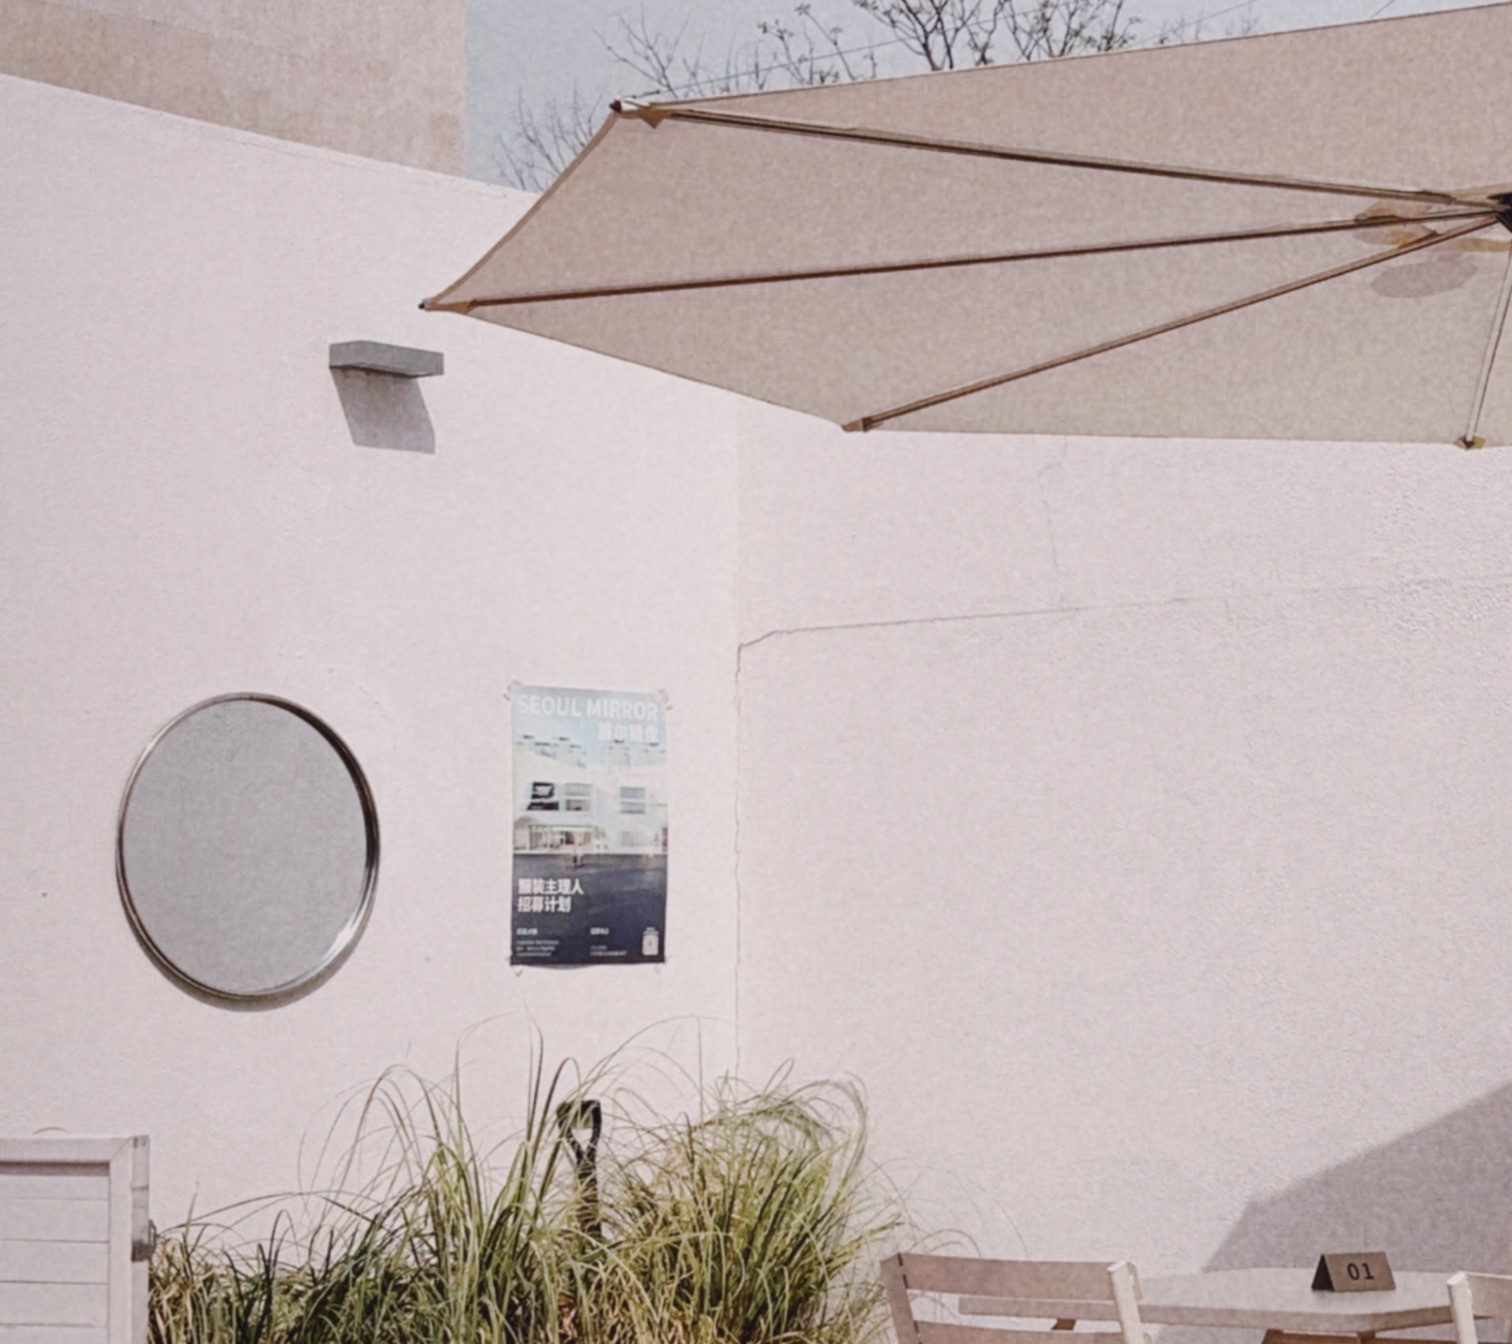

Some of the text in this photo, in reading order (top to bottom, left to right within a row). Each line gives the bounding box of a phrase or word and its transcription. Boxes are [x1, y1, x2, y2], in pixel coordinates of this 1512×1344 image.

[517, 693, 658, 721] SEOUL MIRROR
[518, 877, 584, 895] 服装主理人
[517, 895, 572, 913] 招募计划
[1347, 1262, 1375, 1281] 01
